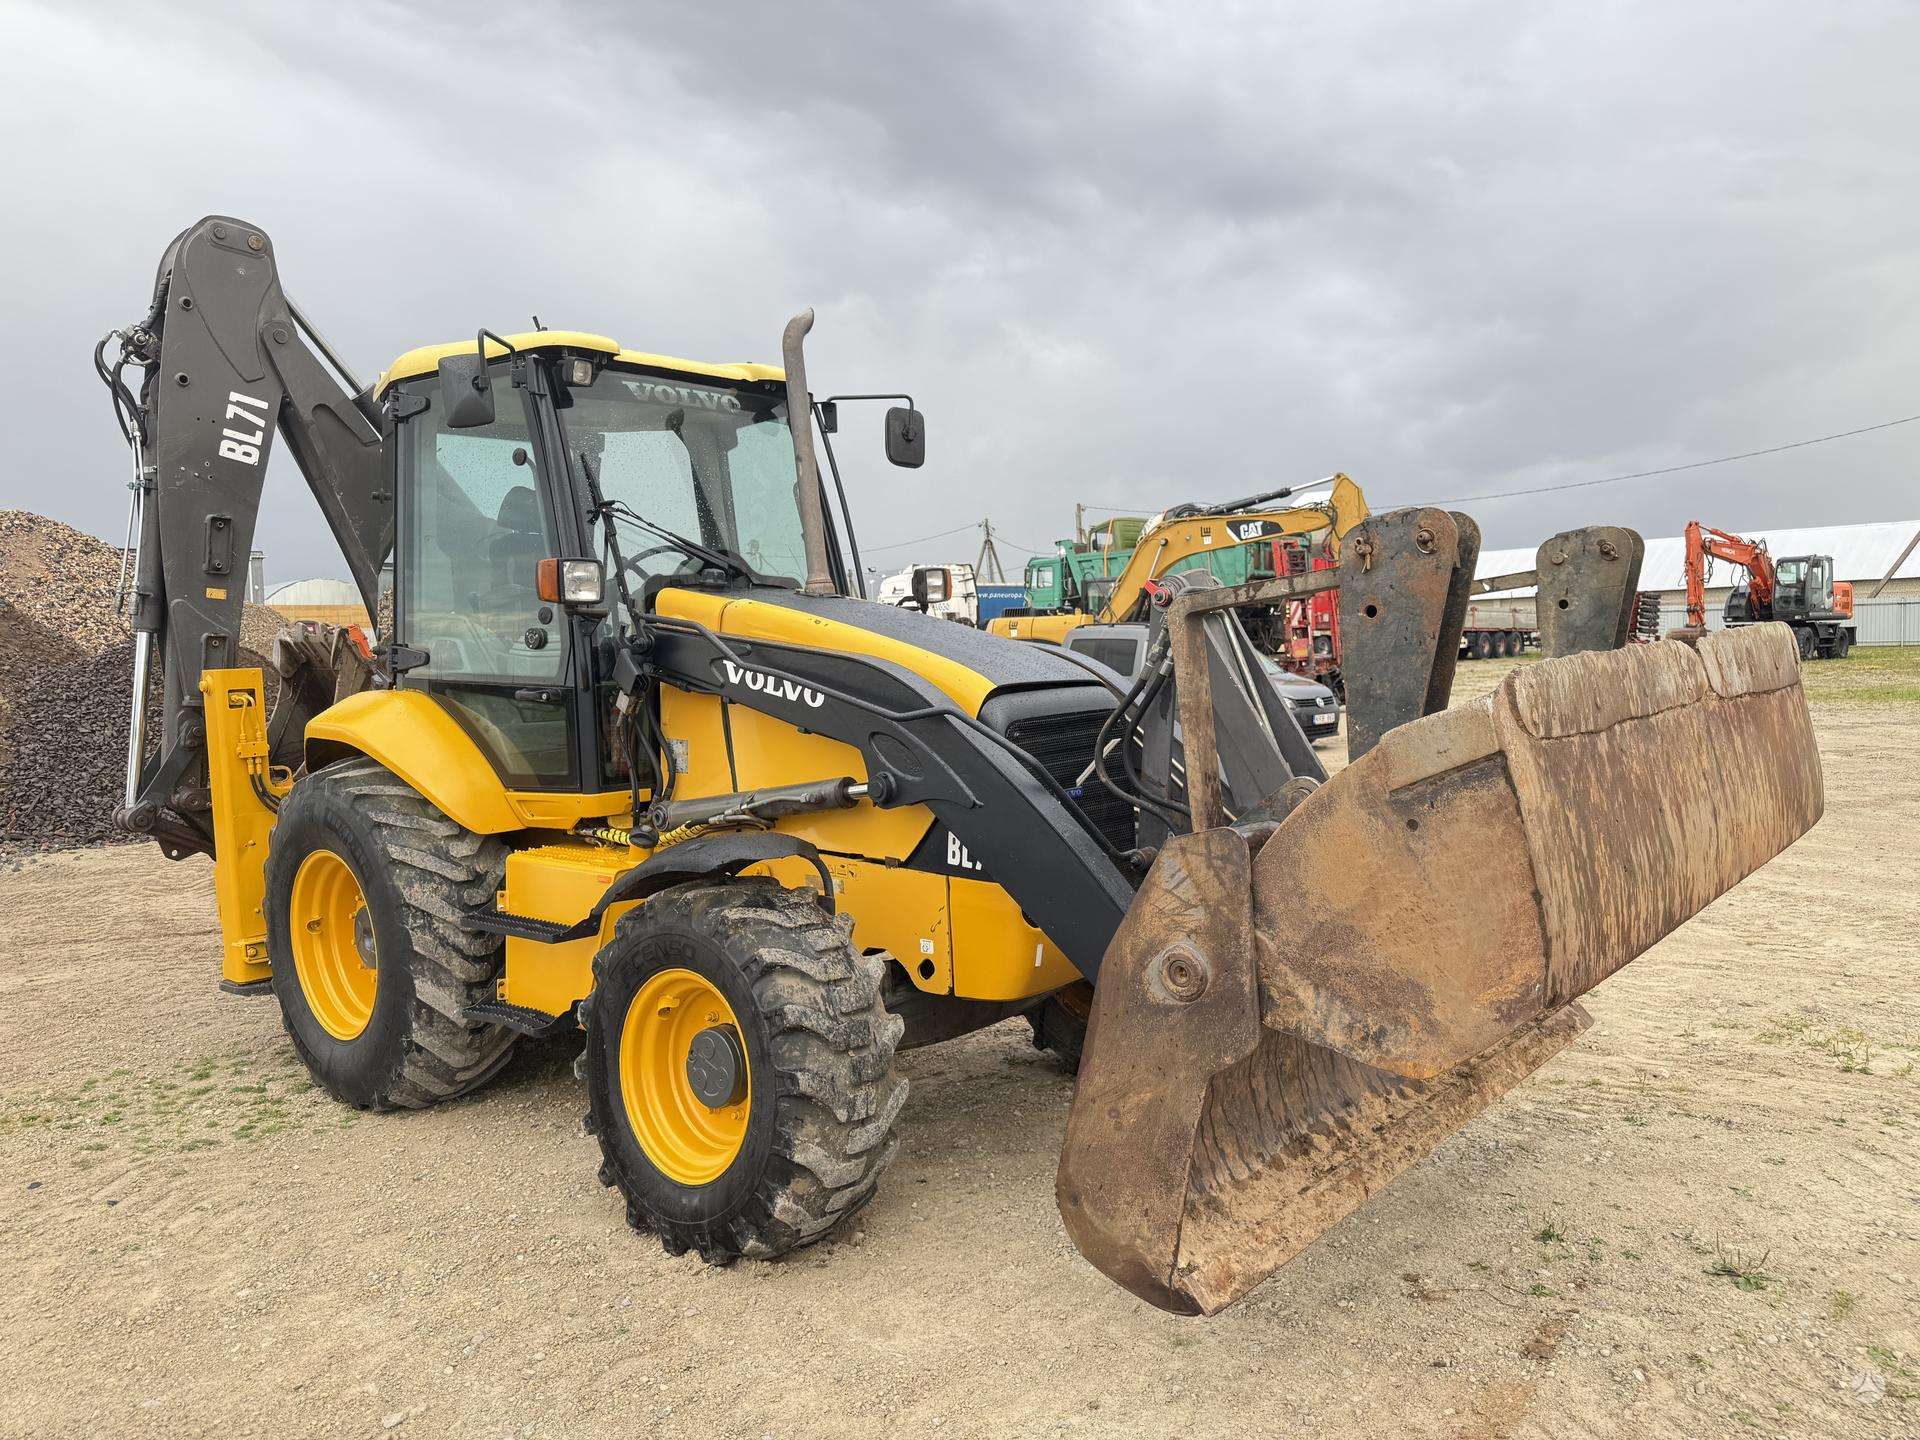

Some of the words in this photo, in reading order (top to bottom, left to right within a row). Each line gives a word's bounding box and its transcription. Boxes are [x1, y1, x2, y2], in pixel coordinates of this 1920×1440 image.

[622, 380, 741, 413] VOLVO
[218, 391, 269, 466] BL71
[1239, 521, 1264, 540] CAT
[723, 660, 825, 708] VOLVO
[947, 830, 983, 871] BL
